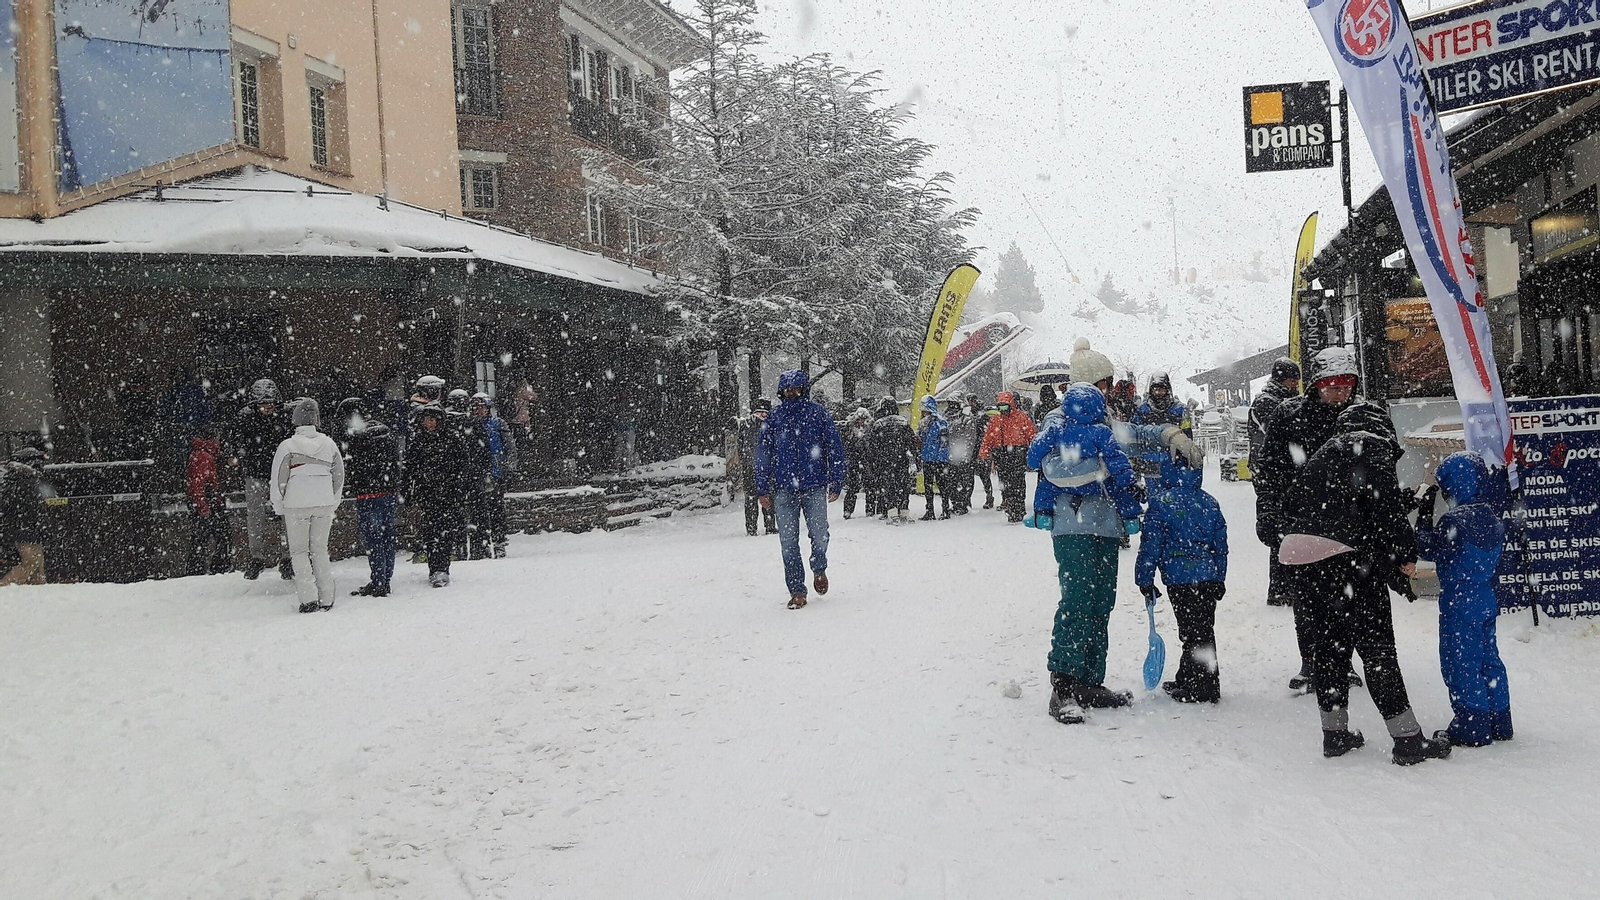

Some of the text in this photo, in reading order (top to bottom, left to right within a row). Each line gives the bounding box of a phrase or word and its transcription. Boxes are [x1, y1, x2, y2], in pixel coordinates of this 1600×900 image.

[1433, 70, 1481, 101] ILER
[1488, 59, 1525, 90] SKI
[1252, 123, 1325, 157] pans
[1282, 145, 1326, 162] COMPANY
[933, 290, 957, 346] pans
[1307, 308, 1319, 357] YUNOS
[1525, 475, 1564, 486] MODA
[1524, 487, 1567, 496] FASHION
[1570, 505, 1592, 515] SKI
[1546, 519, 1569, 527] HIRE
[1502, 537, 1600, 551] ALER DE SKIS
[1544, 551, 1580, 560] REPAIR
[1562, 571, 1580, 580] DE
[1542, 583, 1583, 592] SCHOOL
[1547, 604, 1556, 614] A
